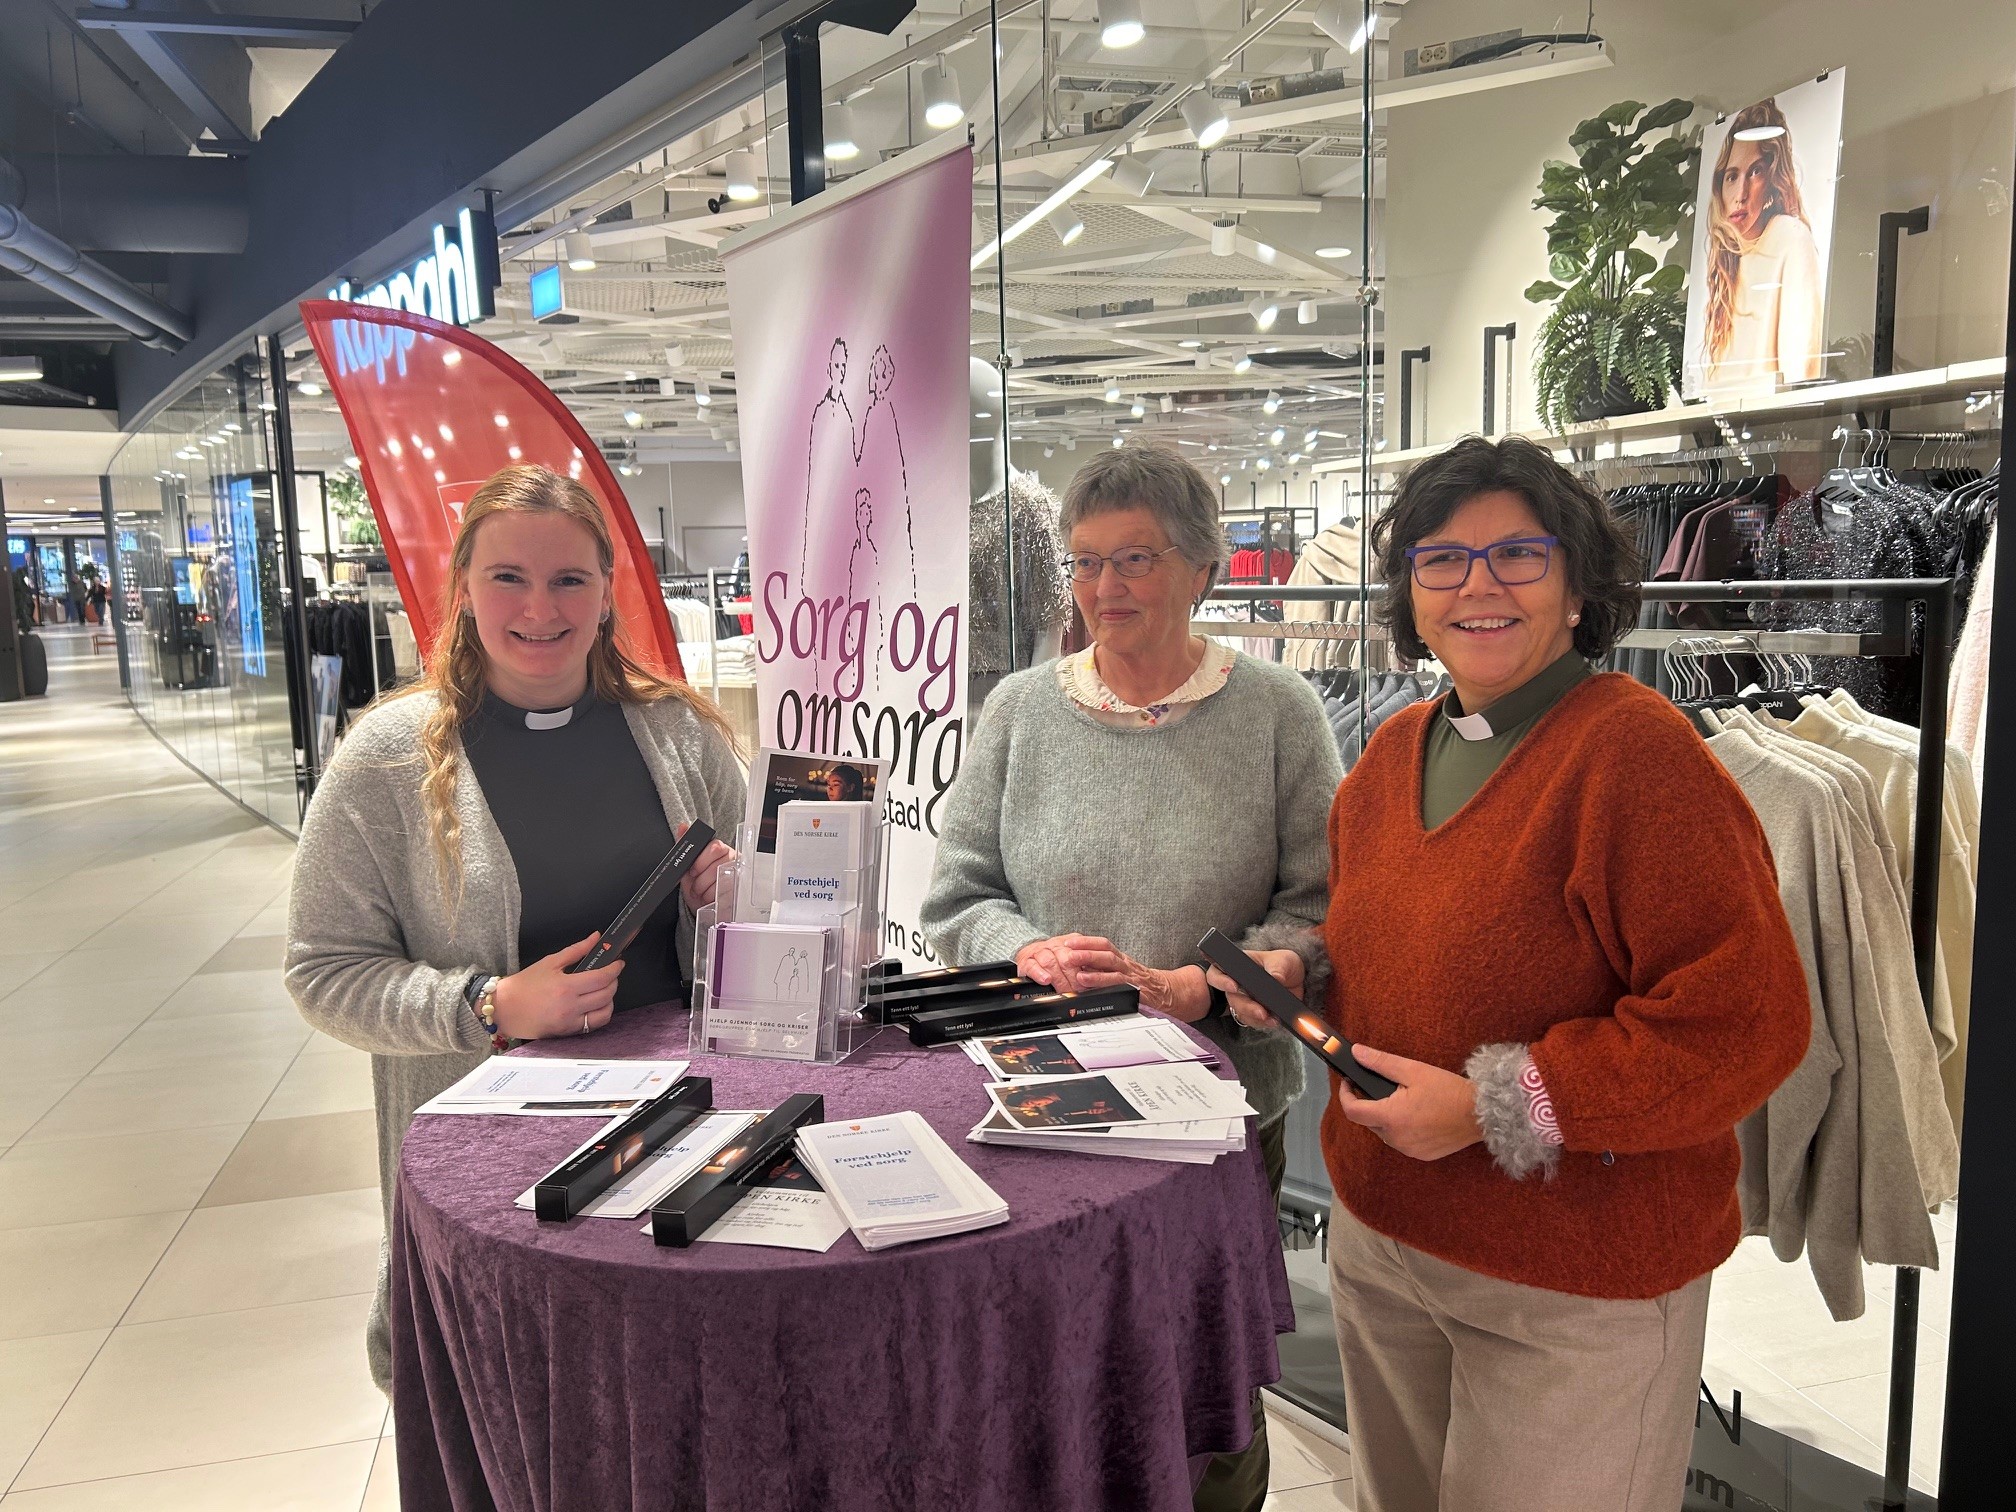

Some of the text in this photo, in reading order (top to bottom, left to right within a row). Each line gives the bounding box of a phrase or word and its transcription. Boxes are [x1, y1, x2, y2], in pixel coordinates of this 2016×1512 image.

[758, 571, 959, 717] Sorg og
[777, 688, 963, 839] omsorg
[787, 876, 840, 889] Førstehjelp
[794, 890, 833, 901] ved sorg
[834, 1148, 912, 1164] Førstehjelp
[849, 1157, 907, 1169] ved sorg
[775, 1195, 821, 1205] KIRKE
